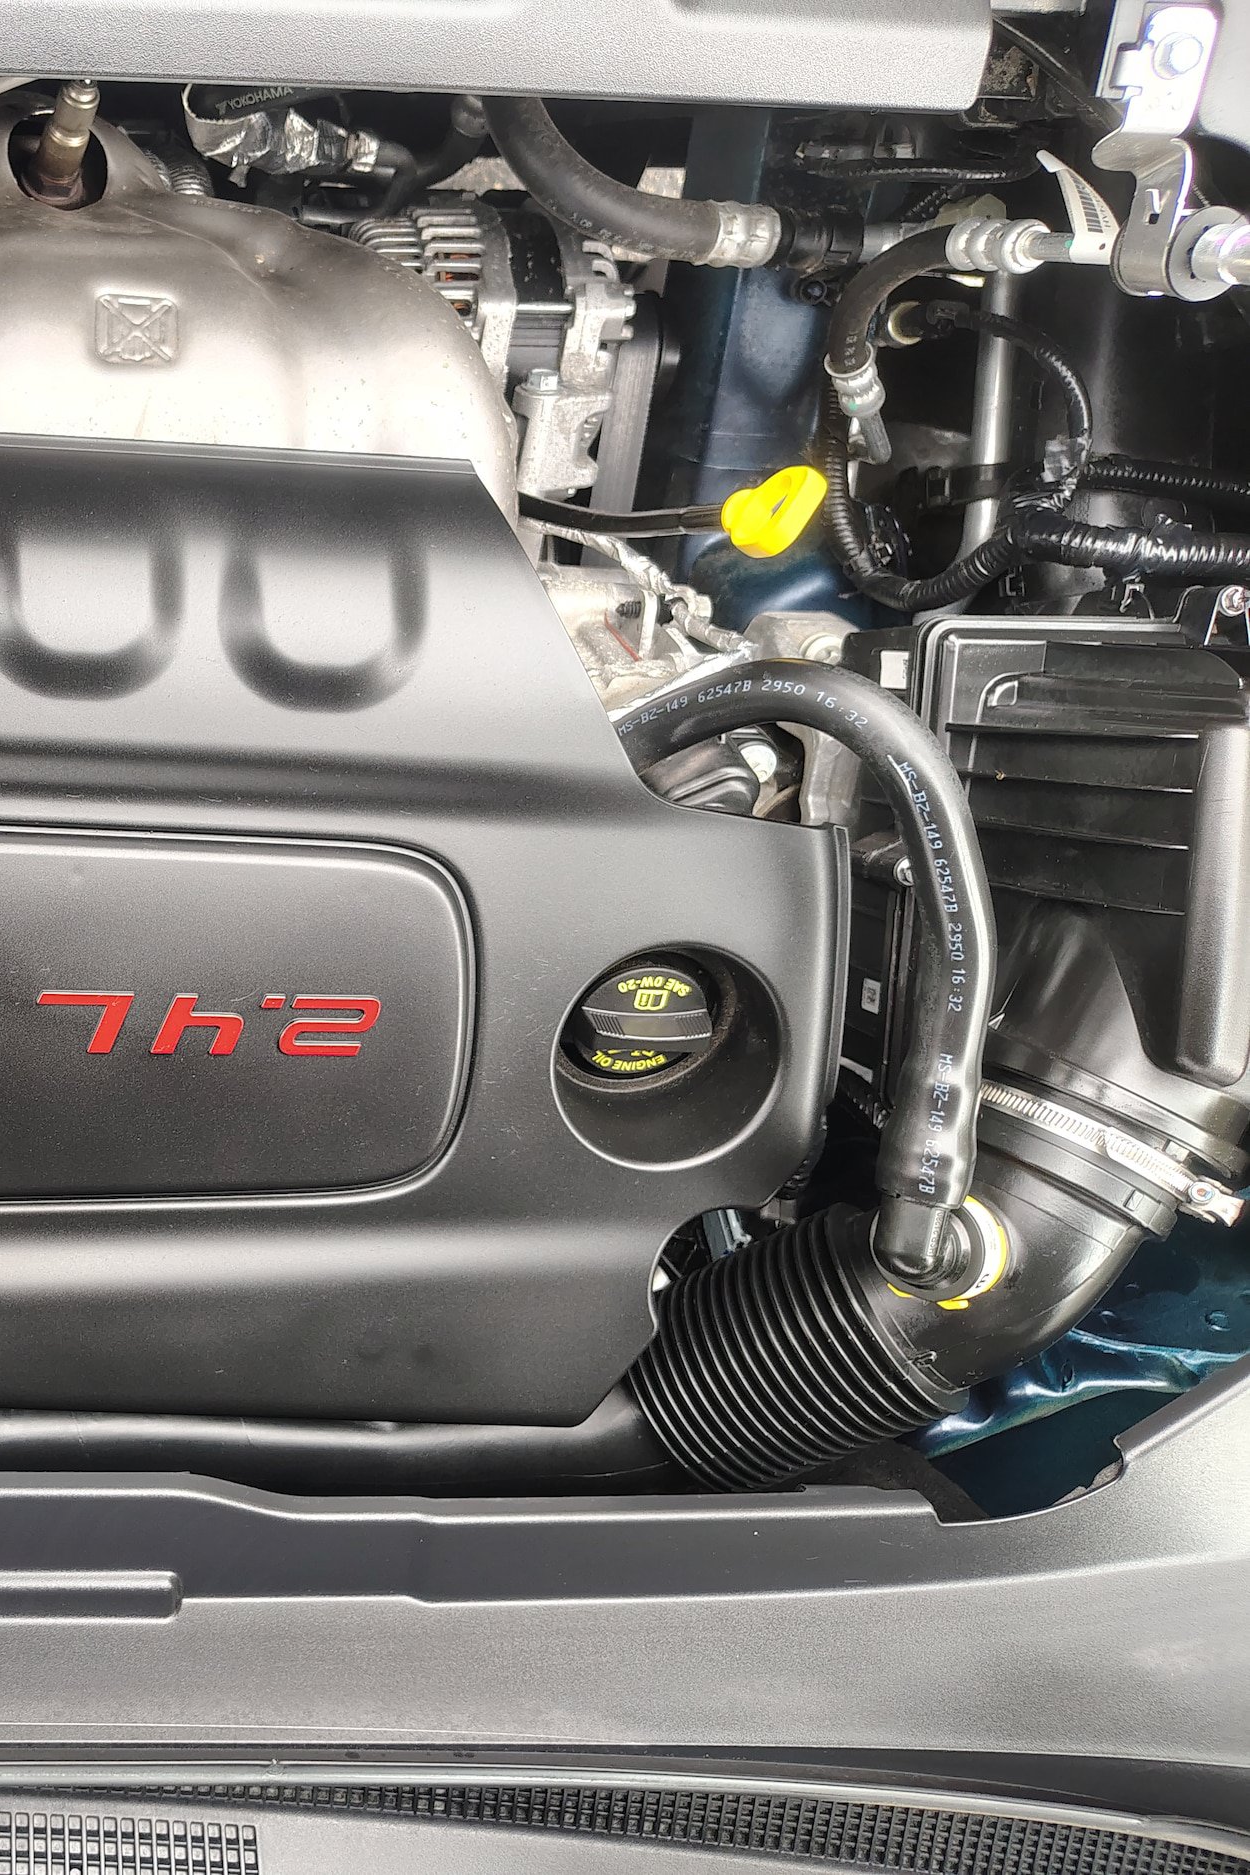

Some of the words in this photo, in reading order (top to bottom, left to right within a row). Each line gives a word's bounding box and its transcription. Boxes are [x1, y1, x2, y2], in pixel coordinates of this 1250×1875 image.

[227, 86, 294, 110] YOKOHAMA
[697, 679, 752, 704] 62547B
[760, 678, 806, 696] 2950
[816, 691, 869, 729] 16:32
[948, 923, 965, 961] 2950
[617, 976, 663, 994] 0W-20
[665, 978, 692, 997] SAE
[948, 968, 966, 1012] 16:32
[36, 989, 381, 1056] 2.4L
[591, 1050, 613, 1067] OIL
[612, 1054, 667, 1071] ENGINE
